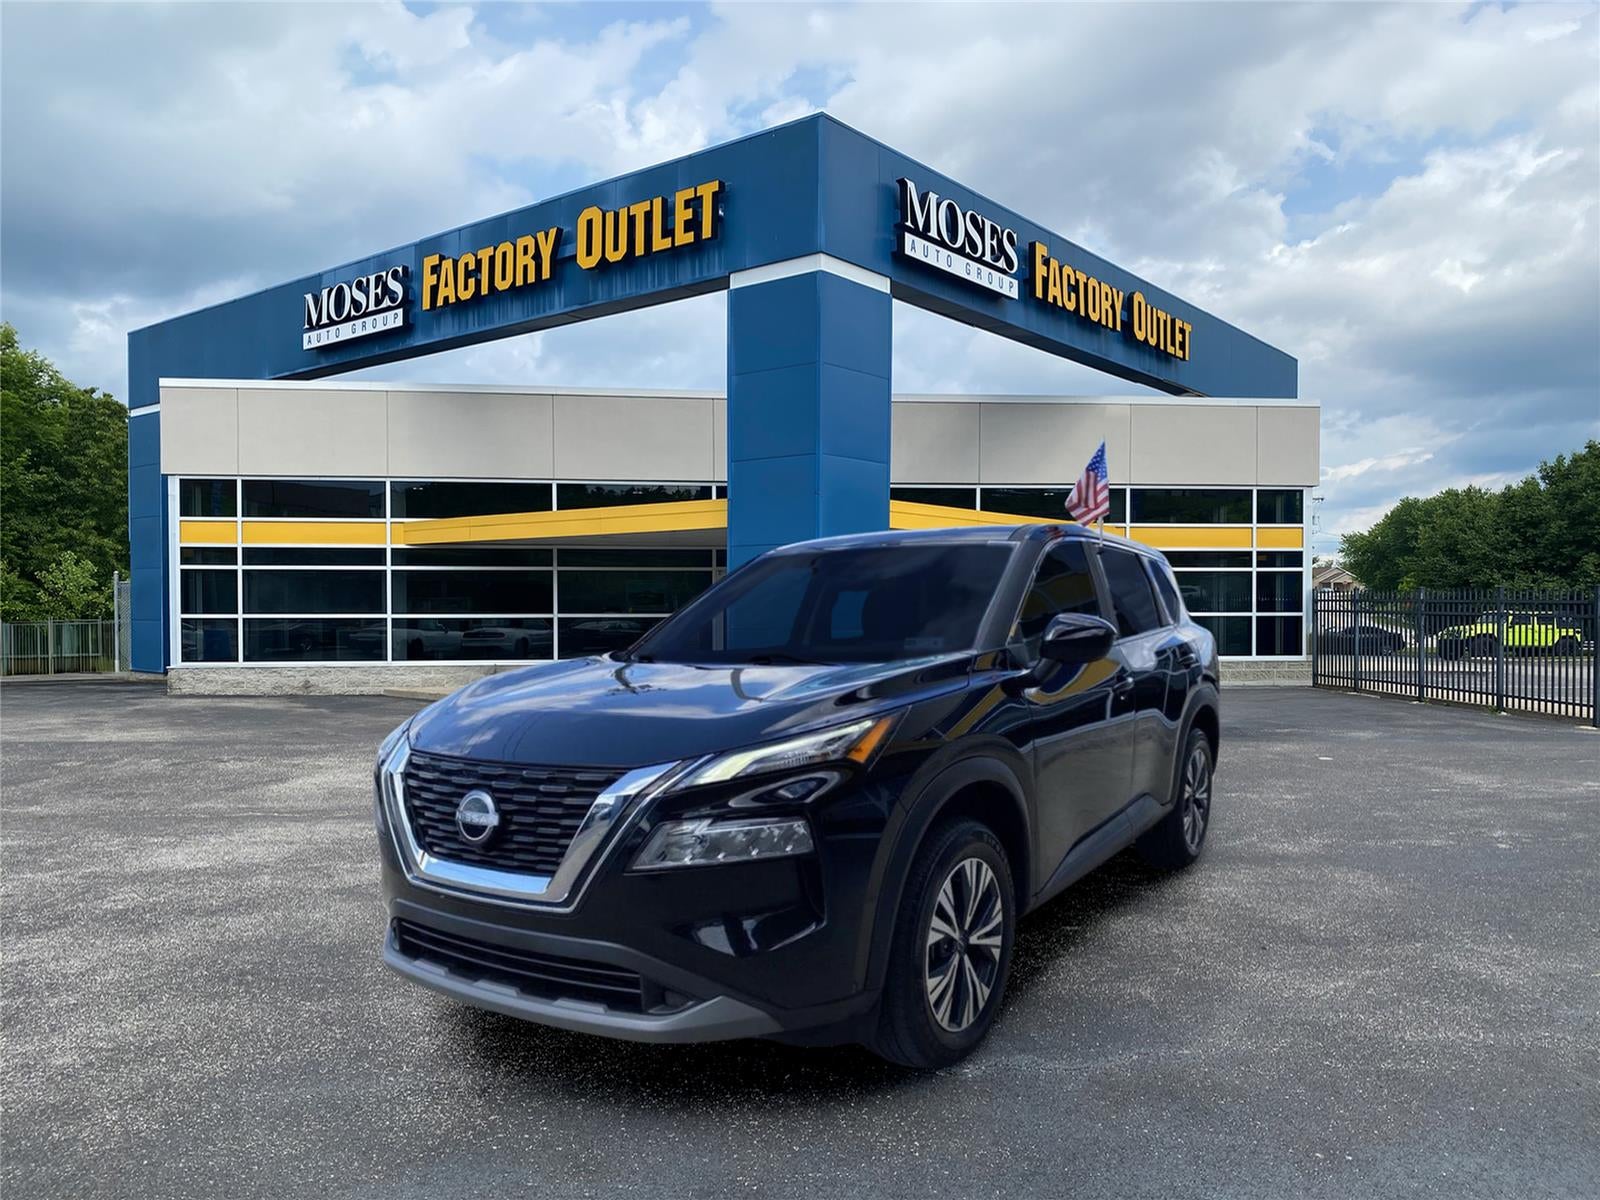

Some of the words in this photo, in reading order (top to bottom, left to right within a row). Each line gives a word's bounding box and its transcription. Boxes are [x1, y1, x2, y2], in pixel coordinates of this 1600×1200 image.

[904, 177, 1018, 274] MOSES
[910, 239, 952, 268] AUTO
[965, 262, 1014, 293] GROUP
[303, 265, 403, 329] MOSES
[307, 328, 340, 346] AUTO
[351, 312, 399, 334] GROUP
